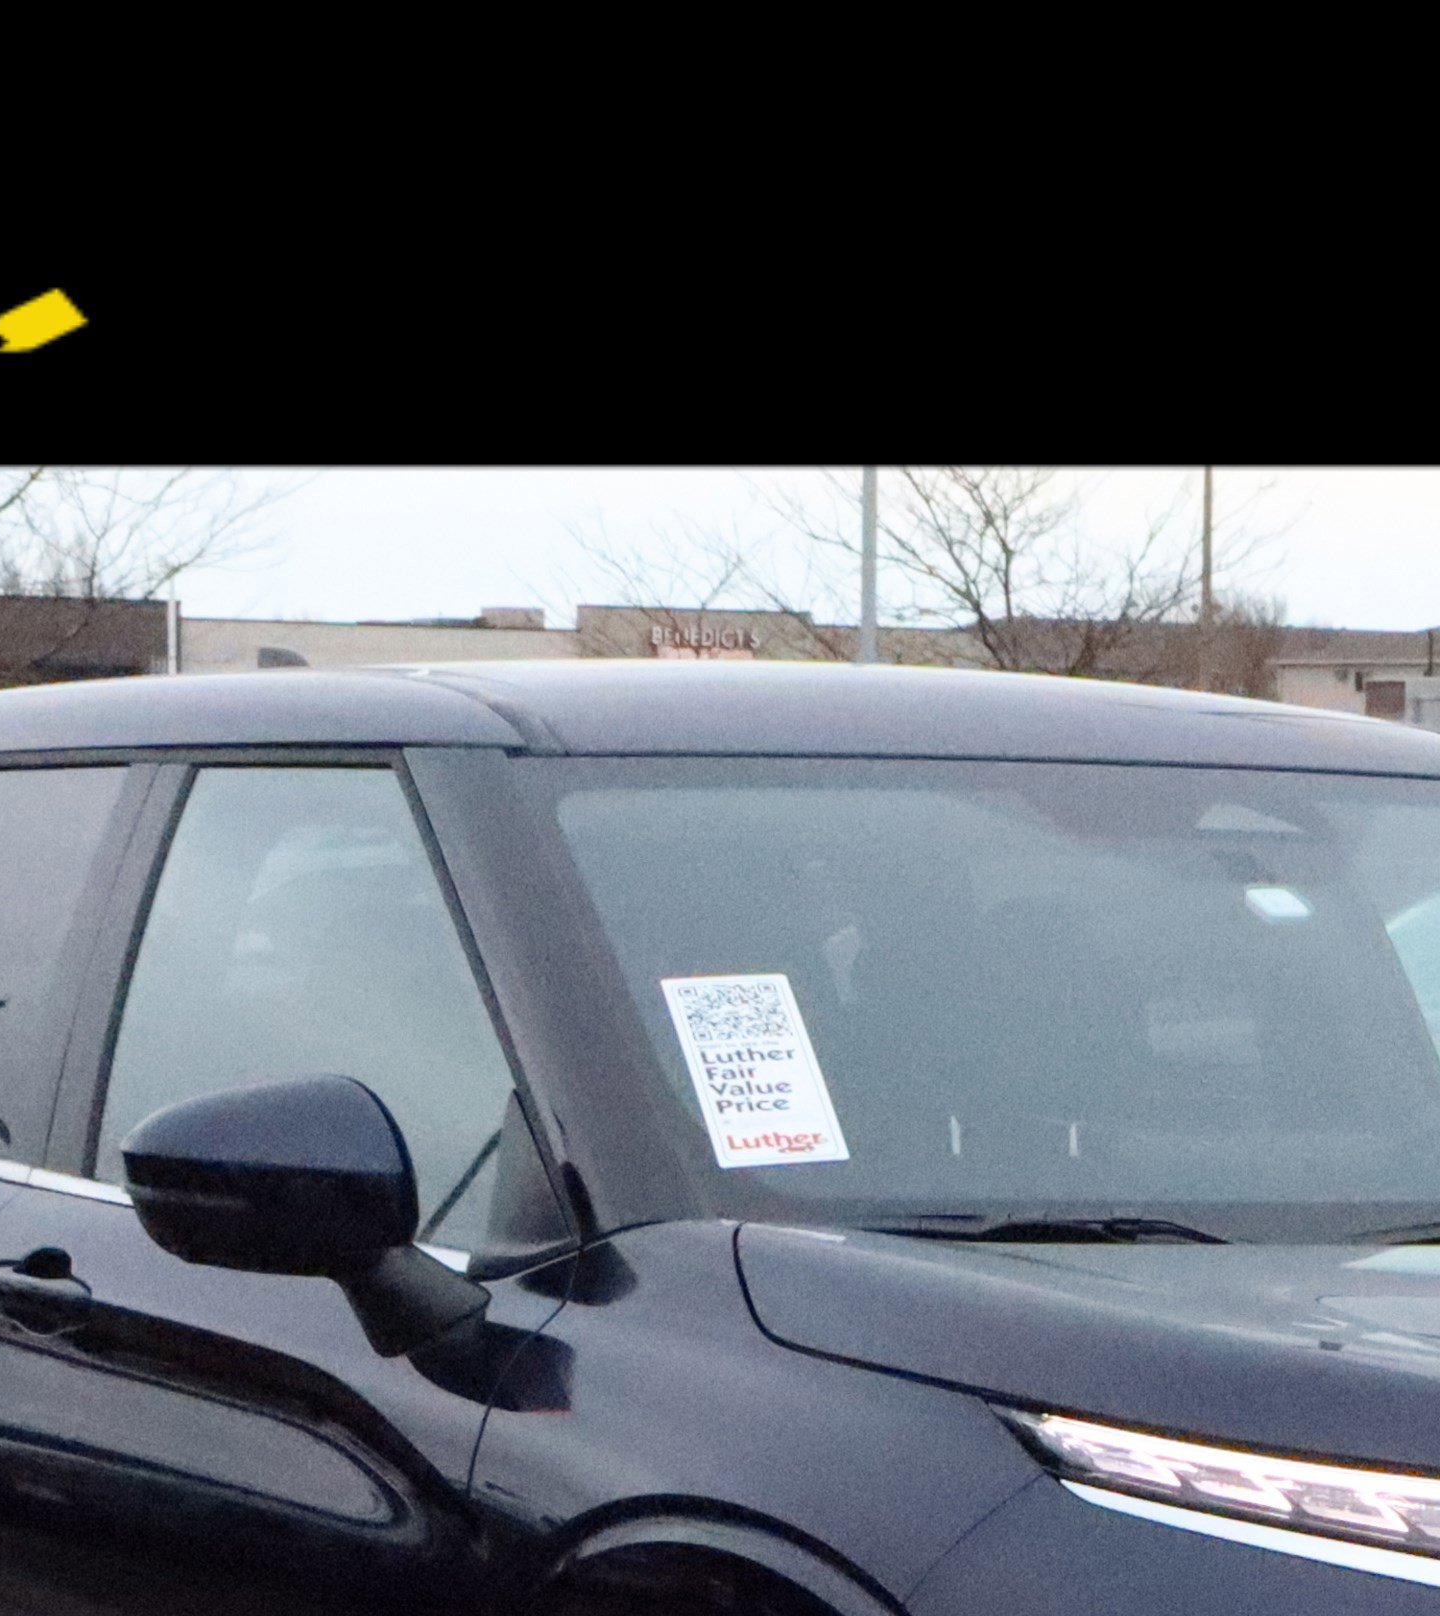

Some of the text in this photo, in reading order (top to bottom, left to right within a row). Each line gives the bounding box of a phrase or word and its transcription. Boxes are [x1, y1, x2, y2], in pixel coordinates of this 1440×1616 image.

[700, 1048, 795, 1065] Luther
[705, 1065, 756, 1081] Fair
[709, 1081, 792, 1096] Value
[716, 1099, 790, 1114] Price
[726, 1132, 823, 1151] Luther
